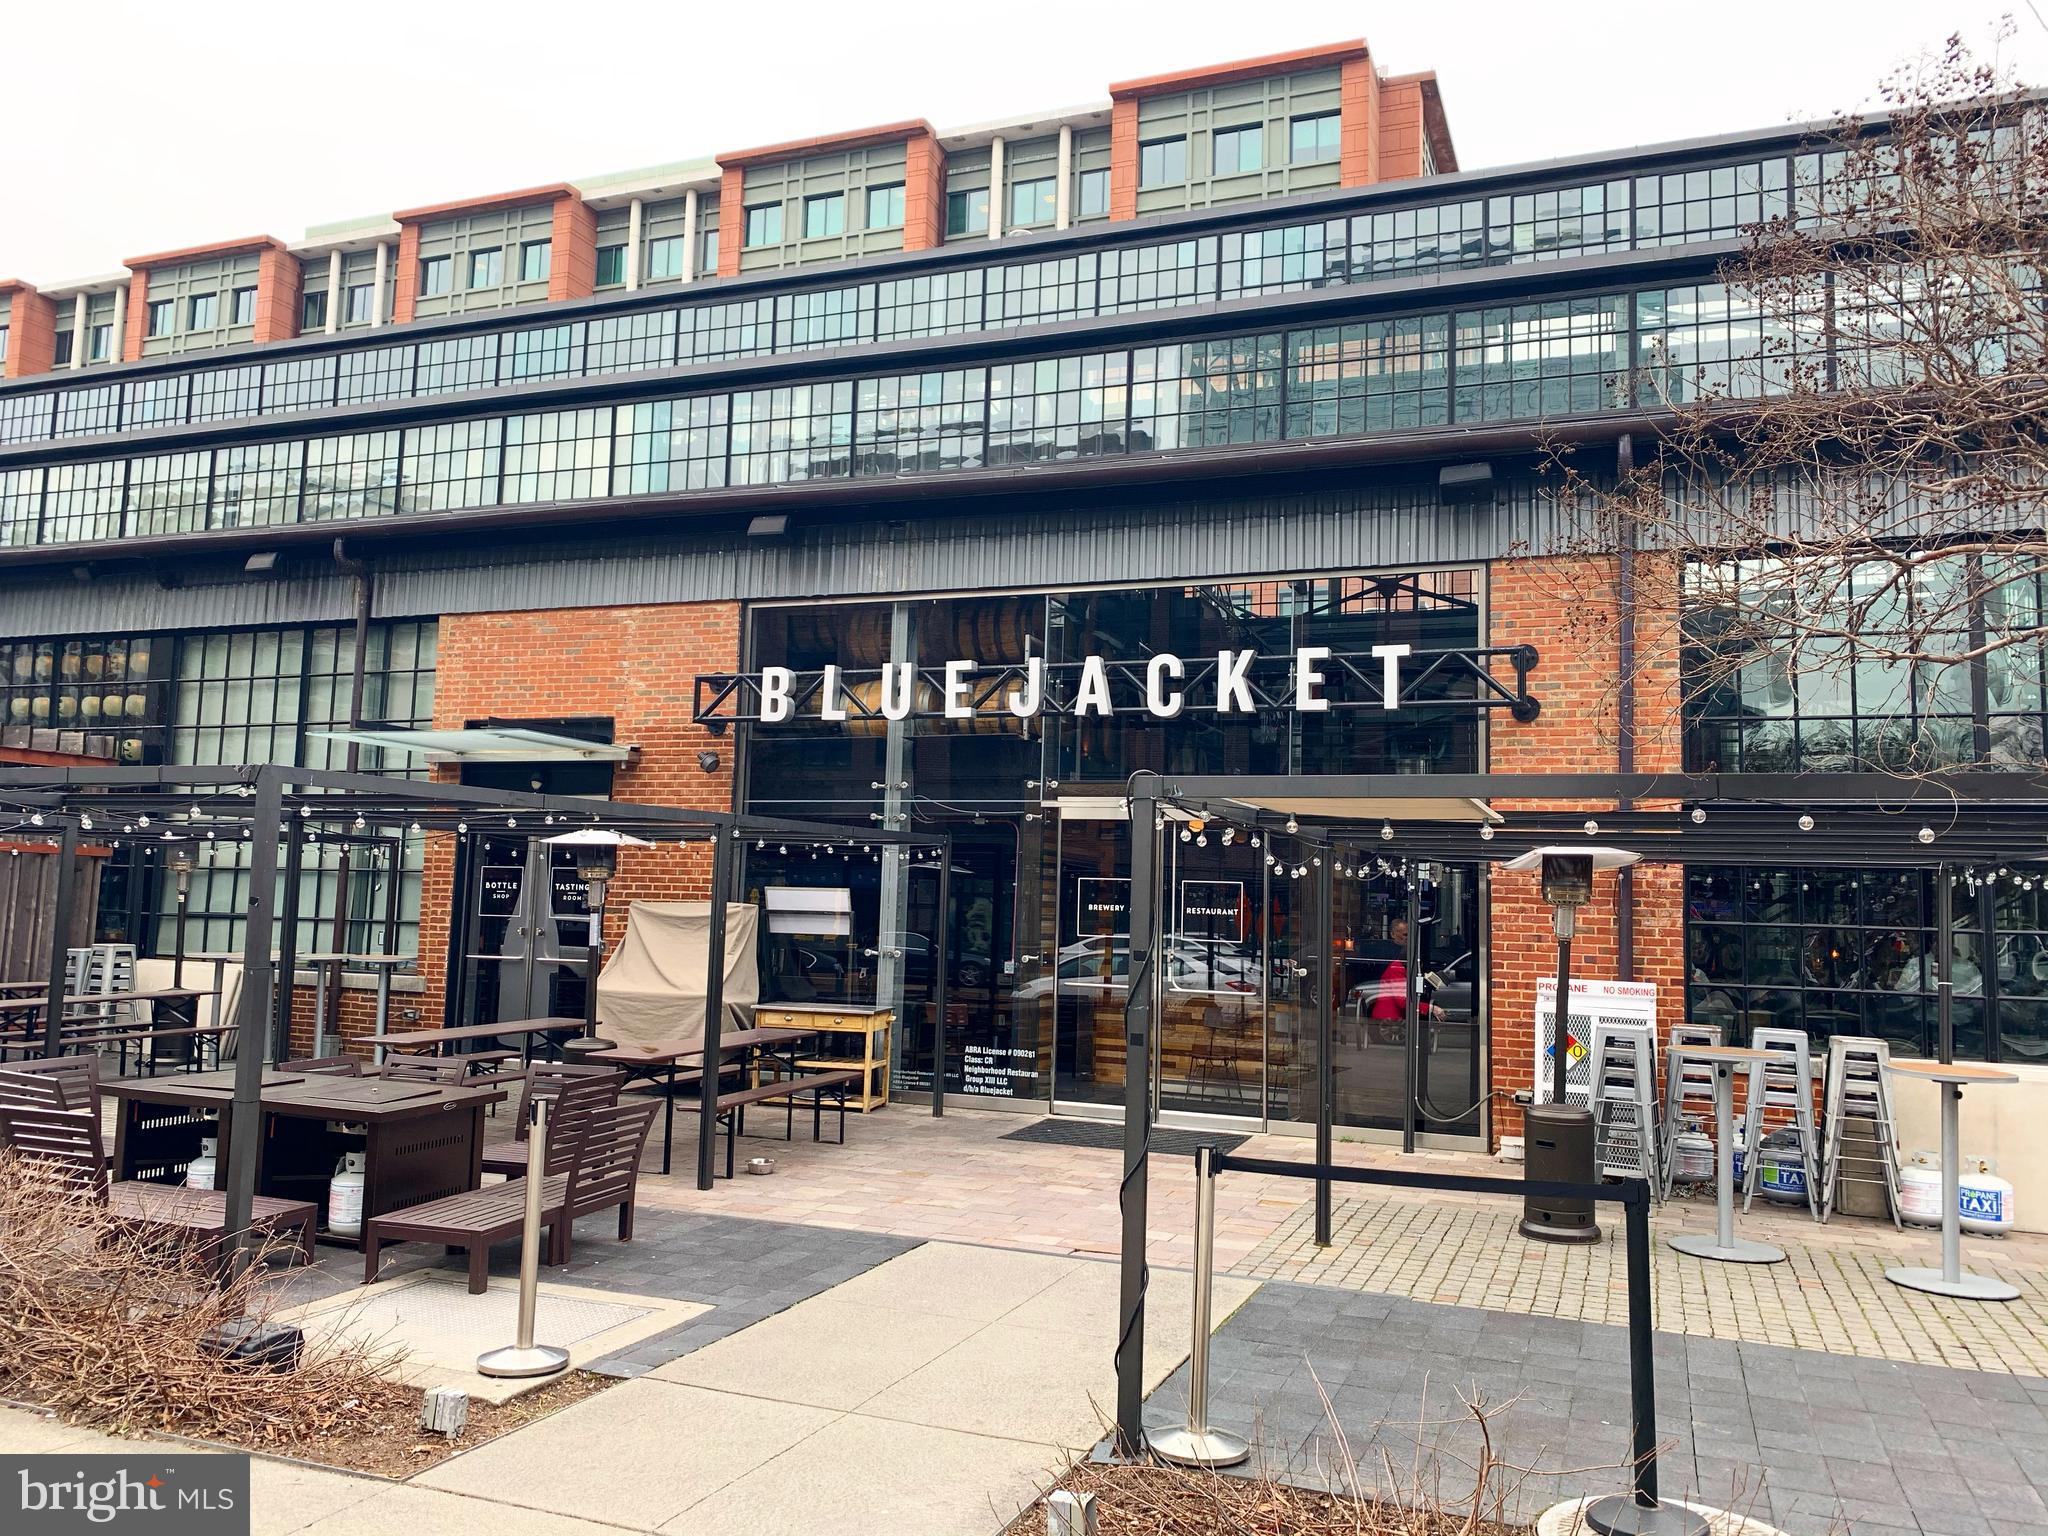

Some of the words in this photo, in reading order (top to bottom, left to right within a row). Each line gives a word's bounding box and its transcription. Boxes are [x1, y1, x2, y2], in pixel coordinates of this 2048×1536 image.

[760, 644, 1411, 723] BLUEJACKET
[485, 882, 518, 890] BOTTLE
[555, 883, 590, 891] TASTING
[1088, 904, 1125, 912] BREWERY
[1186, 907, 1239, 916] RESTAURANT
[1538, 982, 1588, 993] PROANE
[1603, 986, 1616, 995] NO
[1617, 987, 1655, 997] SMOKING
[964, 1045, 982, 1054] ABRA
[982, 1046, 1007, 1056] License
[1007, 1048, 1012, 1056] #
[964, 1055, 983, 1064] Class:
[984, 1056, 993, 1065] CR
[964, 1065, 1006, 1075] Neighborhood
[965, 1075, 984, 1084] Group
[996, 1077, 1008, 1086] LLC
[963, 1084, 979, 1093] d/b/a
[980, 1085, 1013, 1096] Bluejacket
[1960, 1196, 1998, 1213] TAXI
